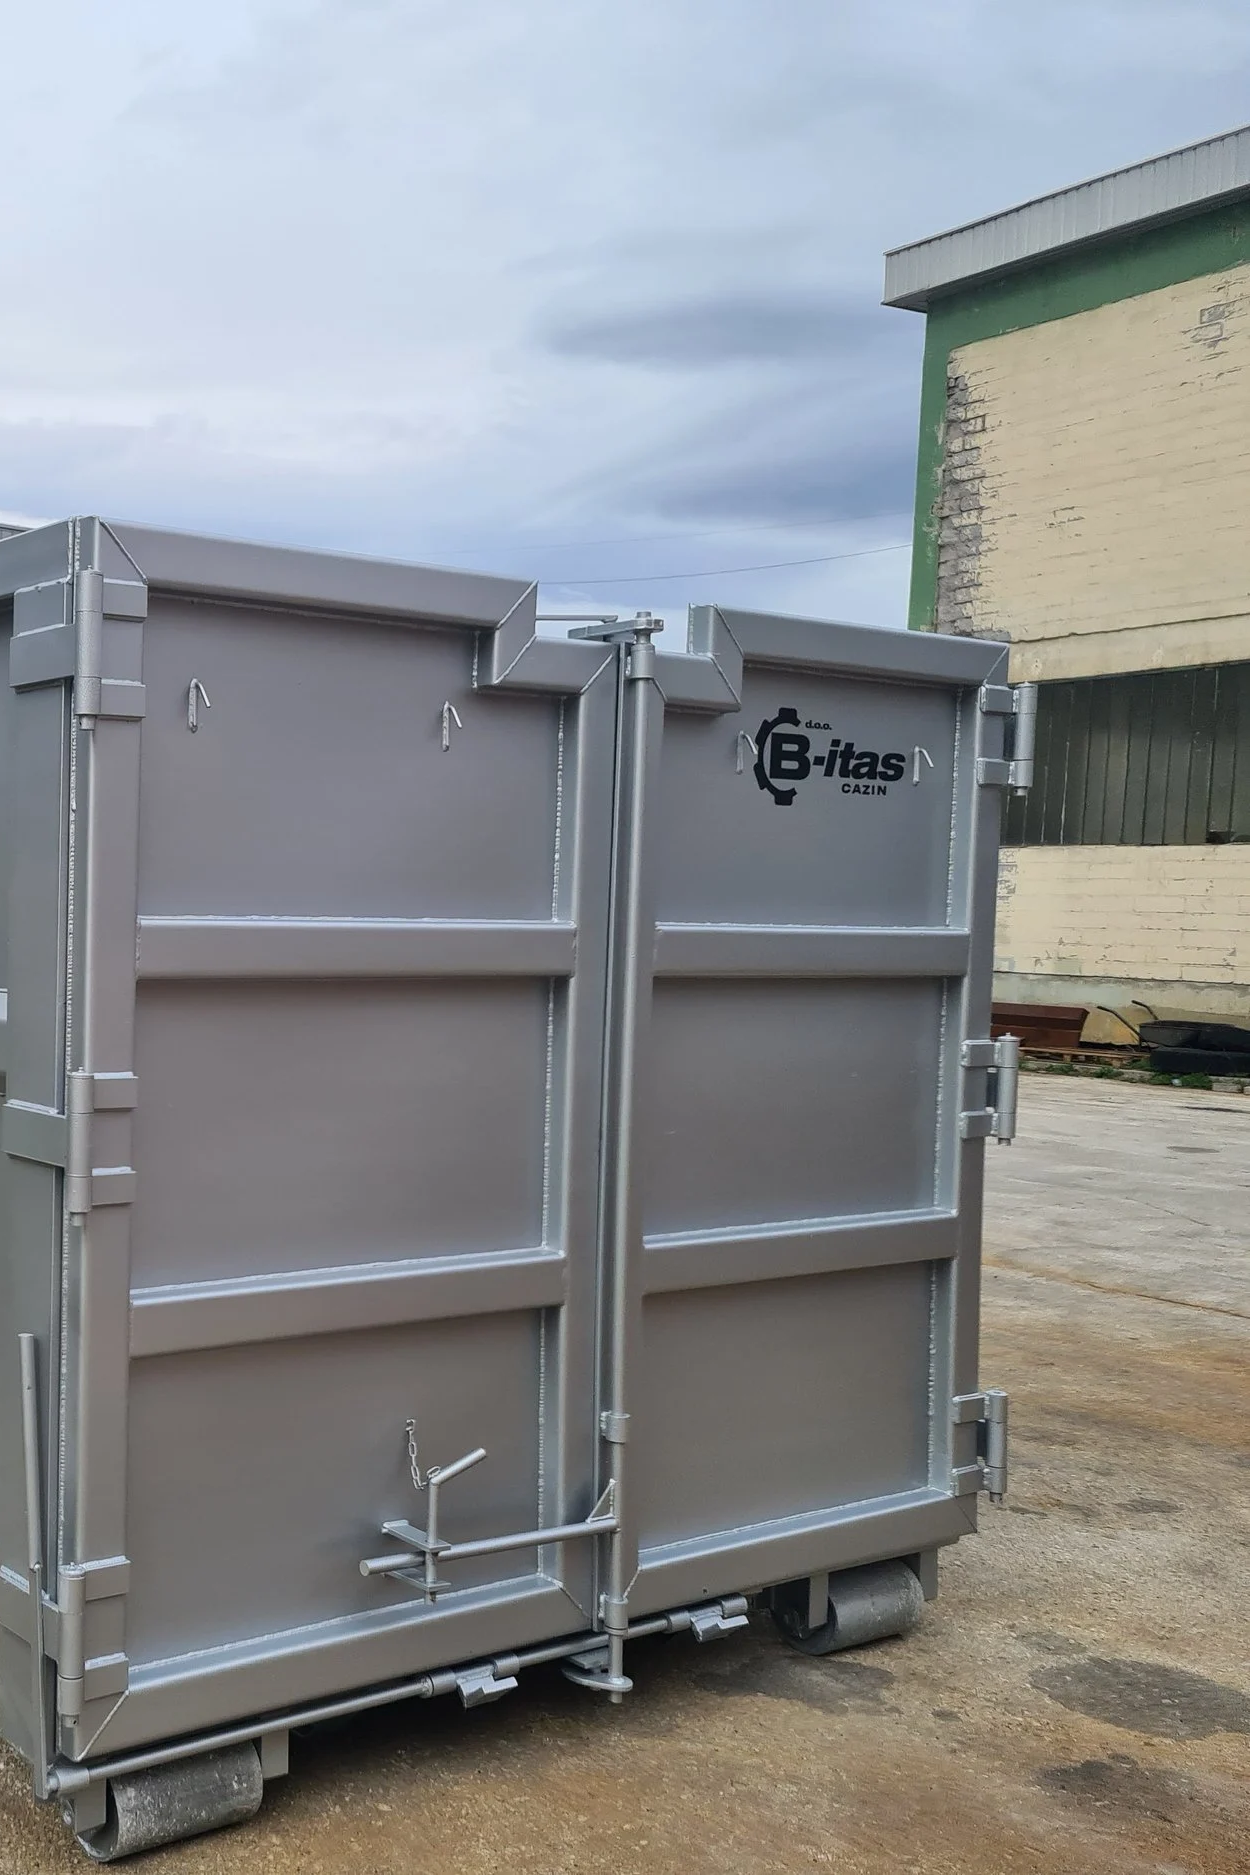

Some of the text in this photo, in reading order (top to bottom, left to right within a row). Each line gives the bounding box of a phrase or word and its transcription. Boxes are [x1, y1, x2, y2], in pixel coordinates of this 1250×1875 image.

[805, 720, 832, 731] d.o.o.
[769, 732, 906, 782] B-itas
[841, 783, 887, 796] CAZIN
